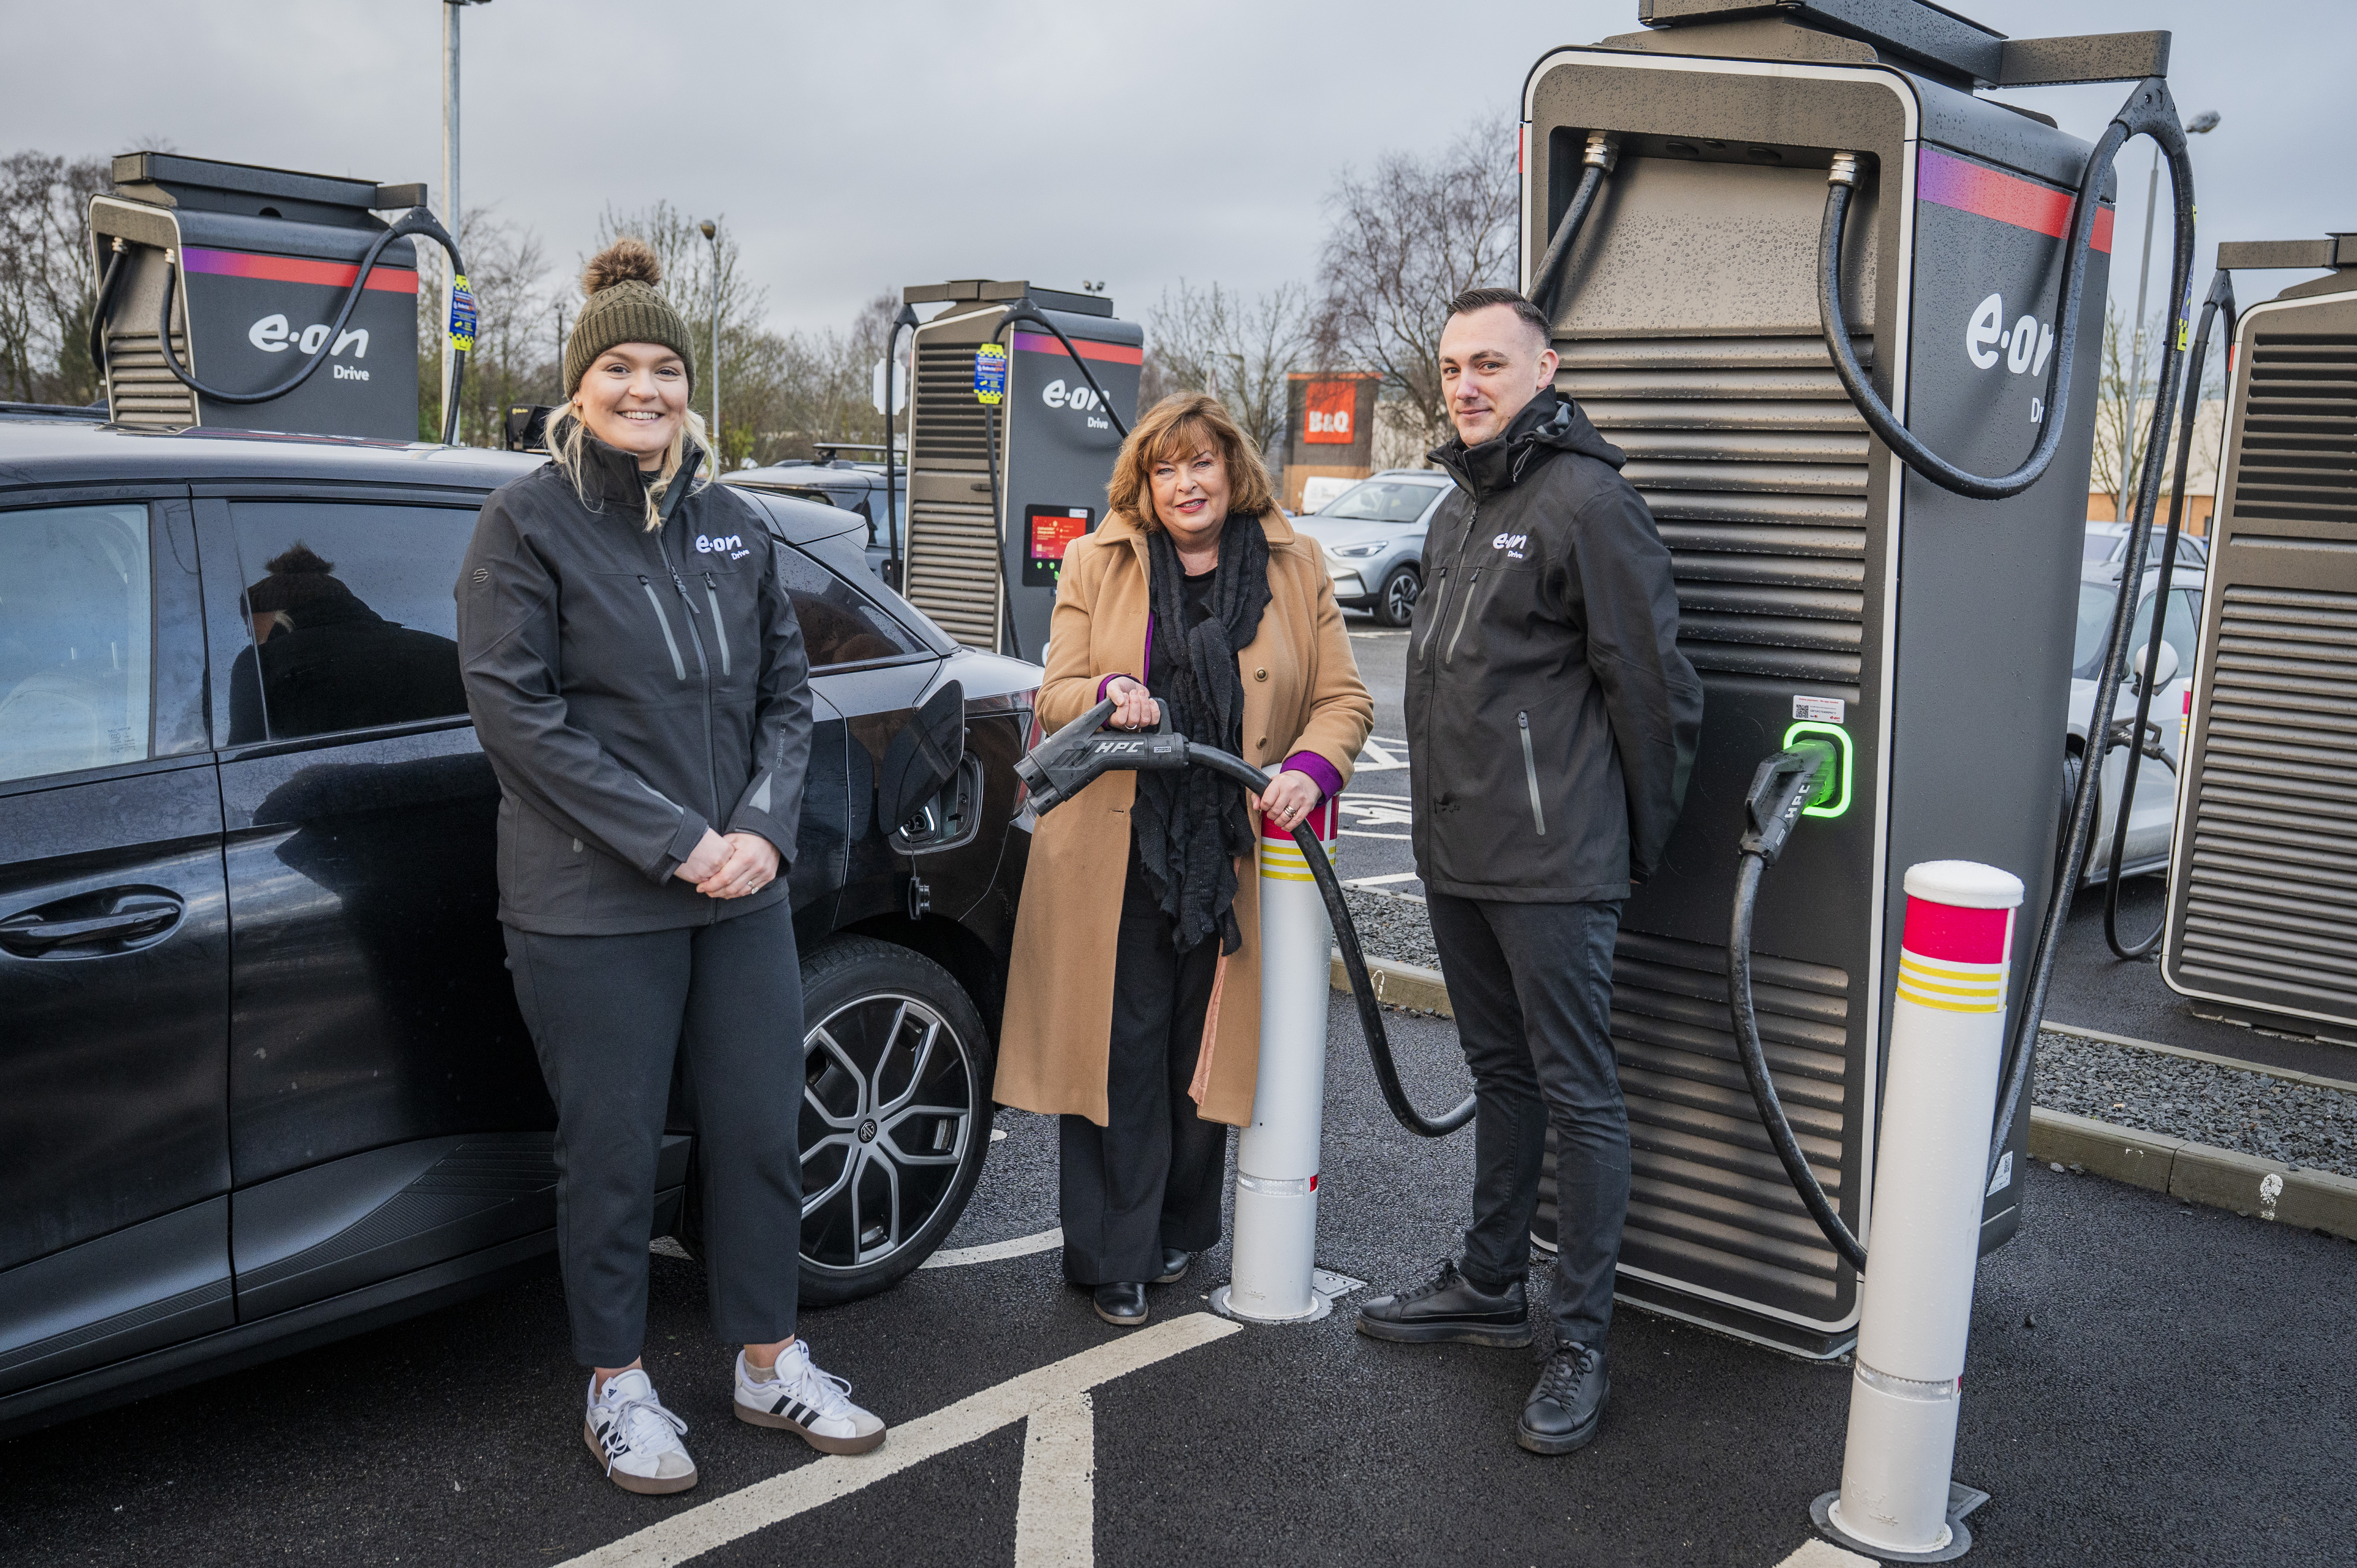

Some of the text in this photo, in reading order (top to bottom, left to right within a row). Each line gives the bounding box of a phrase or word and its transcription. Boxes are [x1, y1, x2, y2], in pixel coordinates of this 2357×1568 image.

[334, 364, 370, 381] Drive
[1087, 416, 1108, 429] Drive
[1309, 411, 1349, 433] B&Q
[731, 549, 750, 560] Drive
[1507, 550, 1523, 559] Drive
[1095, 742, 1144, 753] HPC
[1784, 785, 1811, 818] HPC
[862, 1124, 874, 1139] MG
